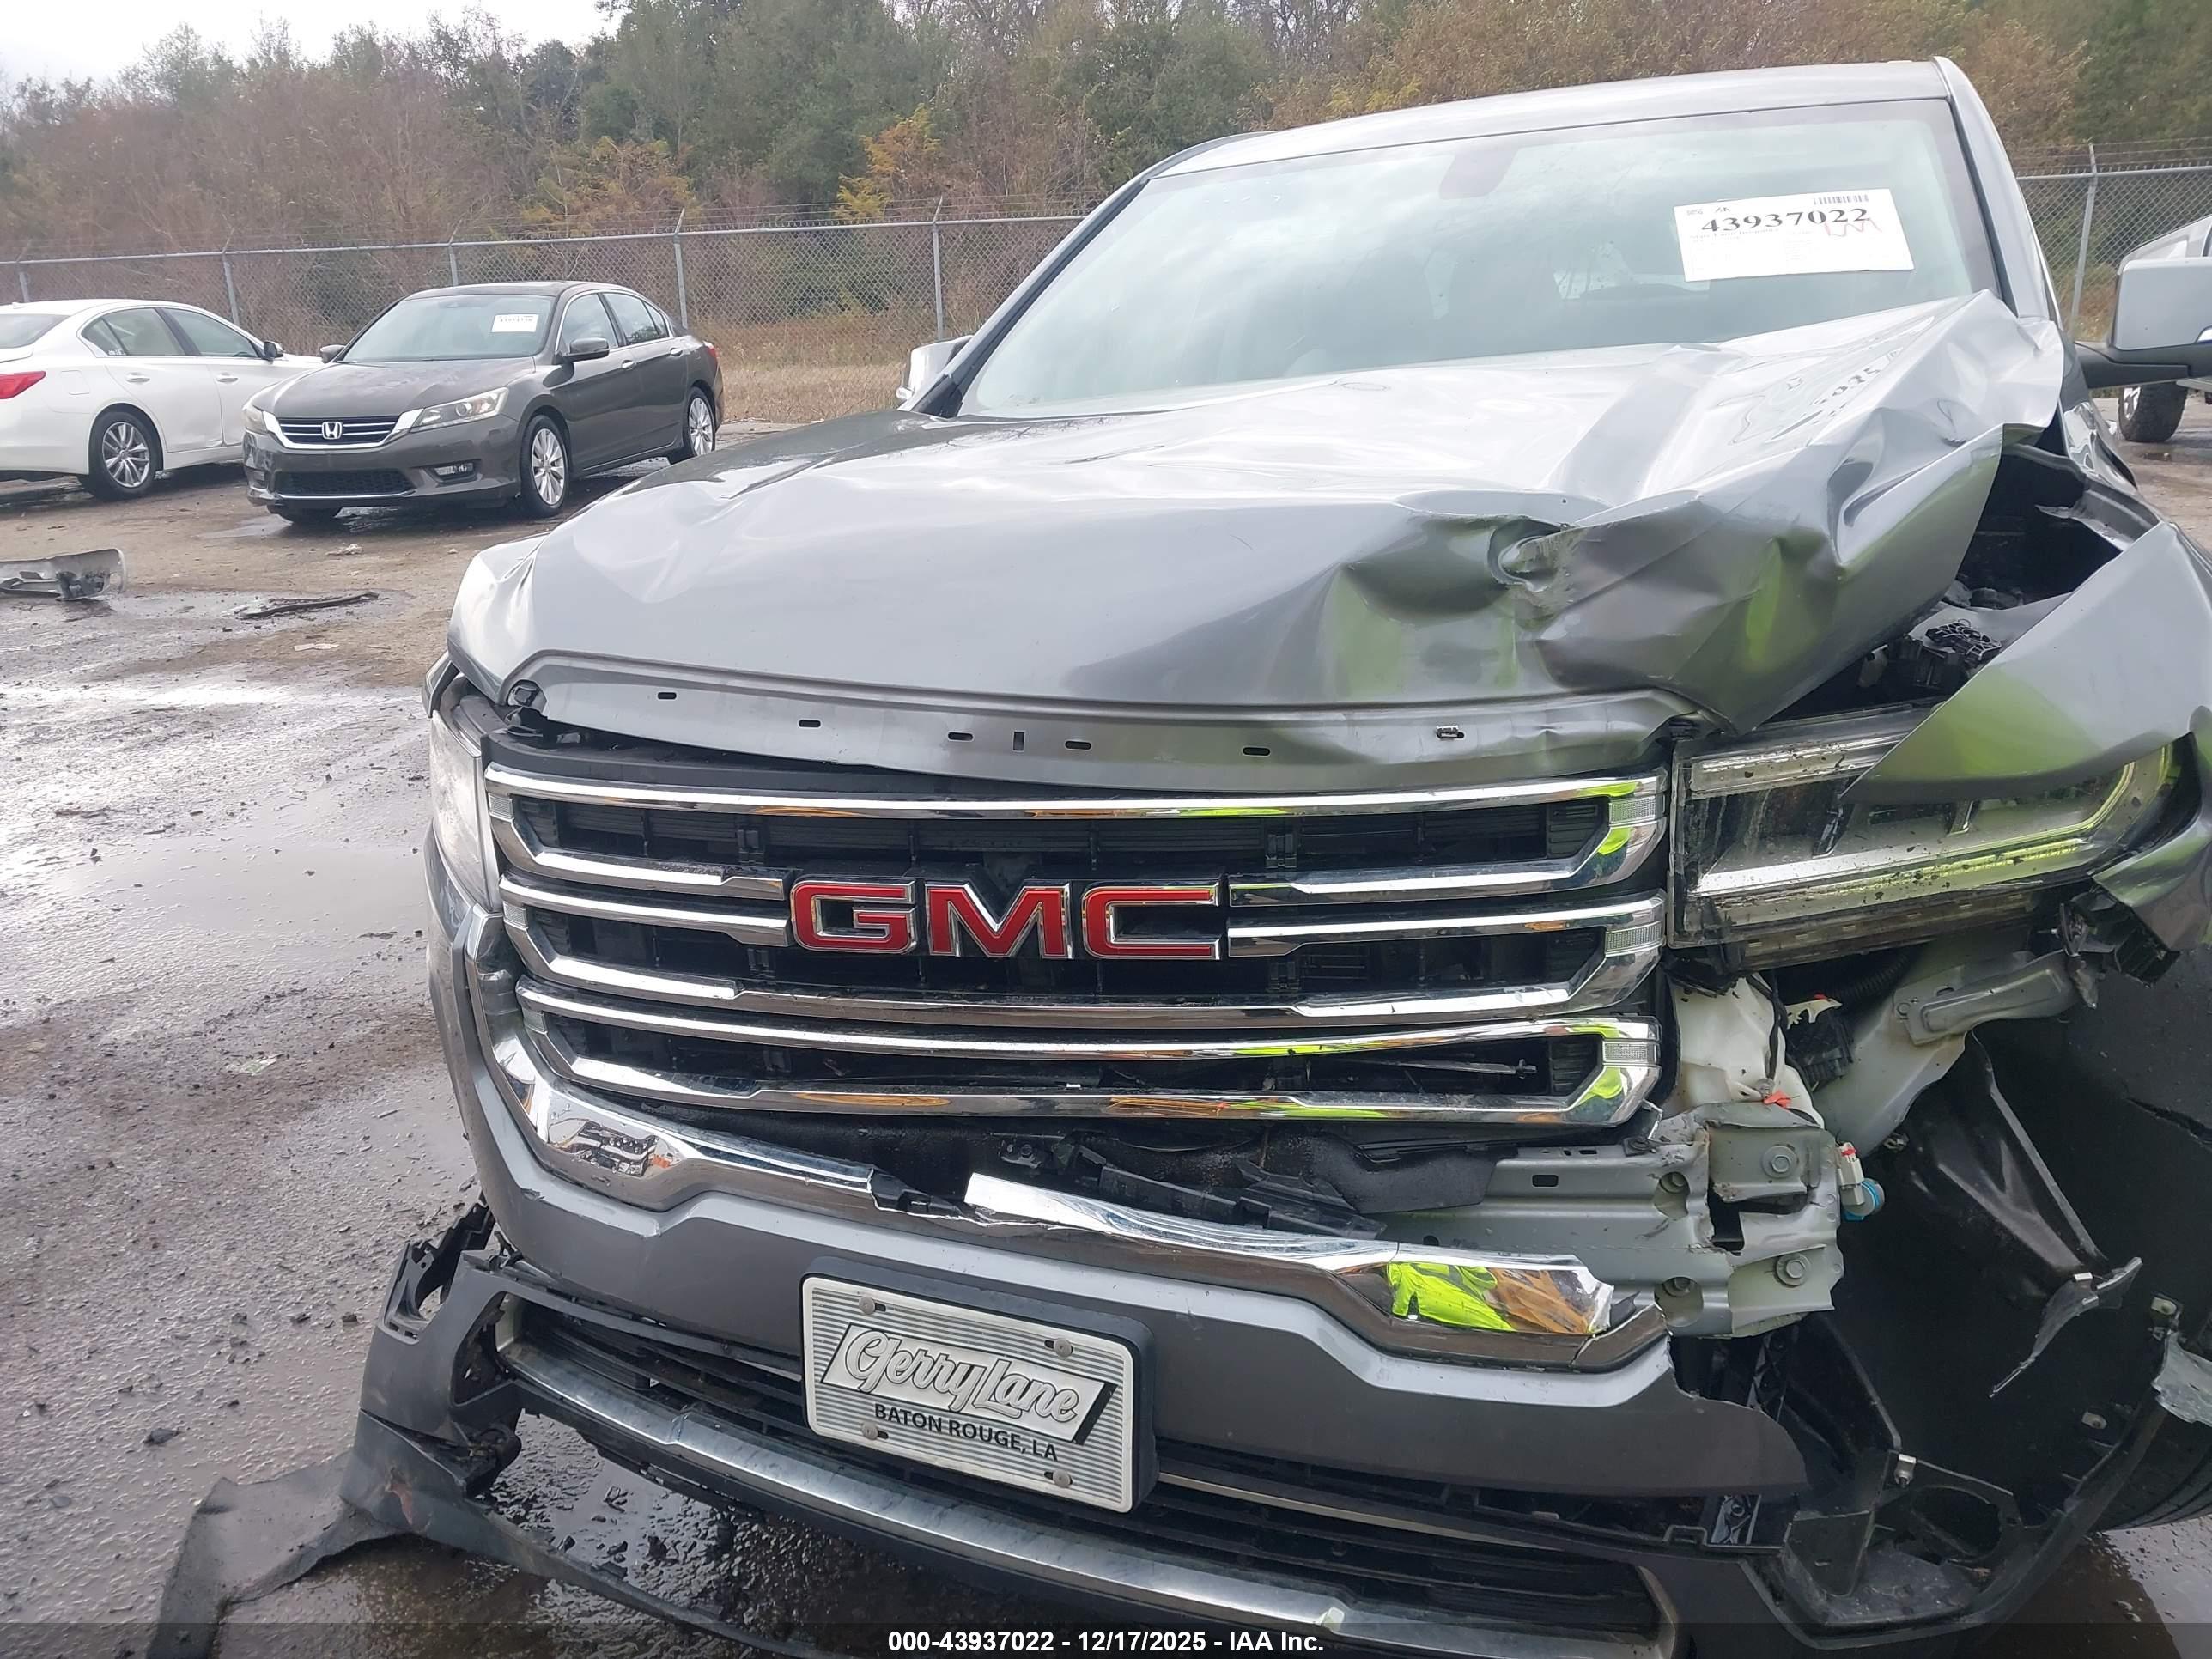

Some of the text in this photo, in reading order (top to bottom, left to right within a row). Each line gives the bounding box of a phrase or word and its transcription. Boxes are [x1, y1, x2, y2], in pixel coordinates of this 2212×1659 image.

[1701, 208, 1869, 232] 43937022
[791, 880, 1220, 960] GMC
[874, 1403, 1057, 1462] BATON ROUGE, LA
